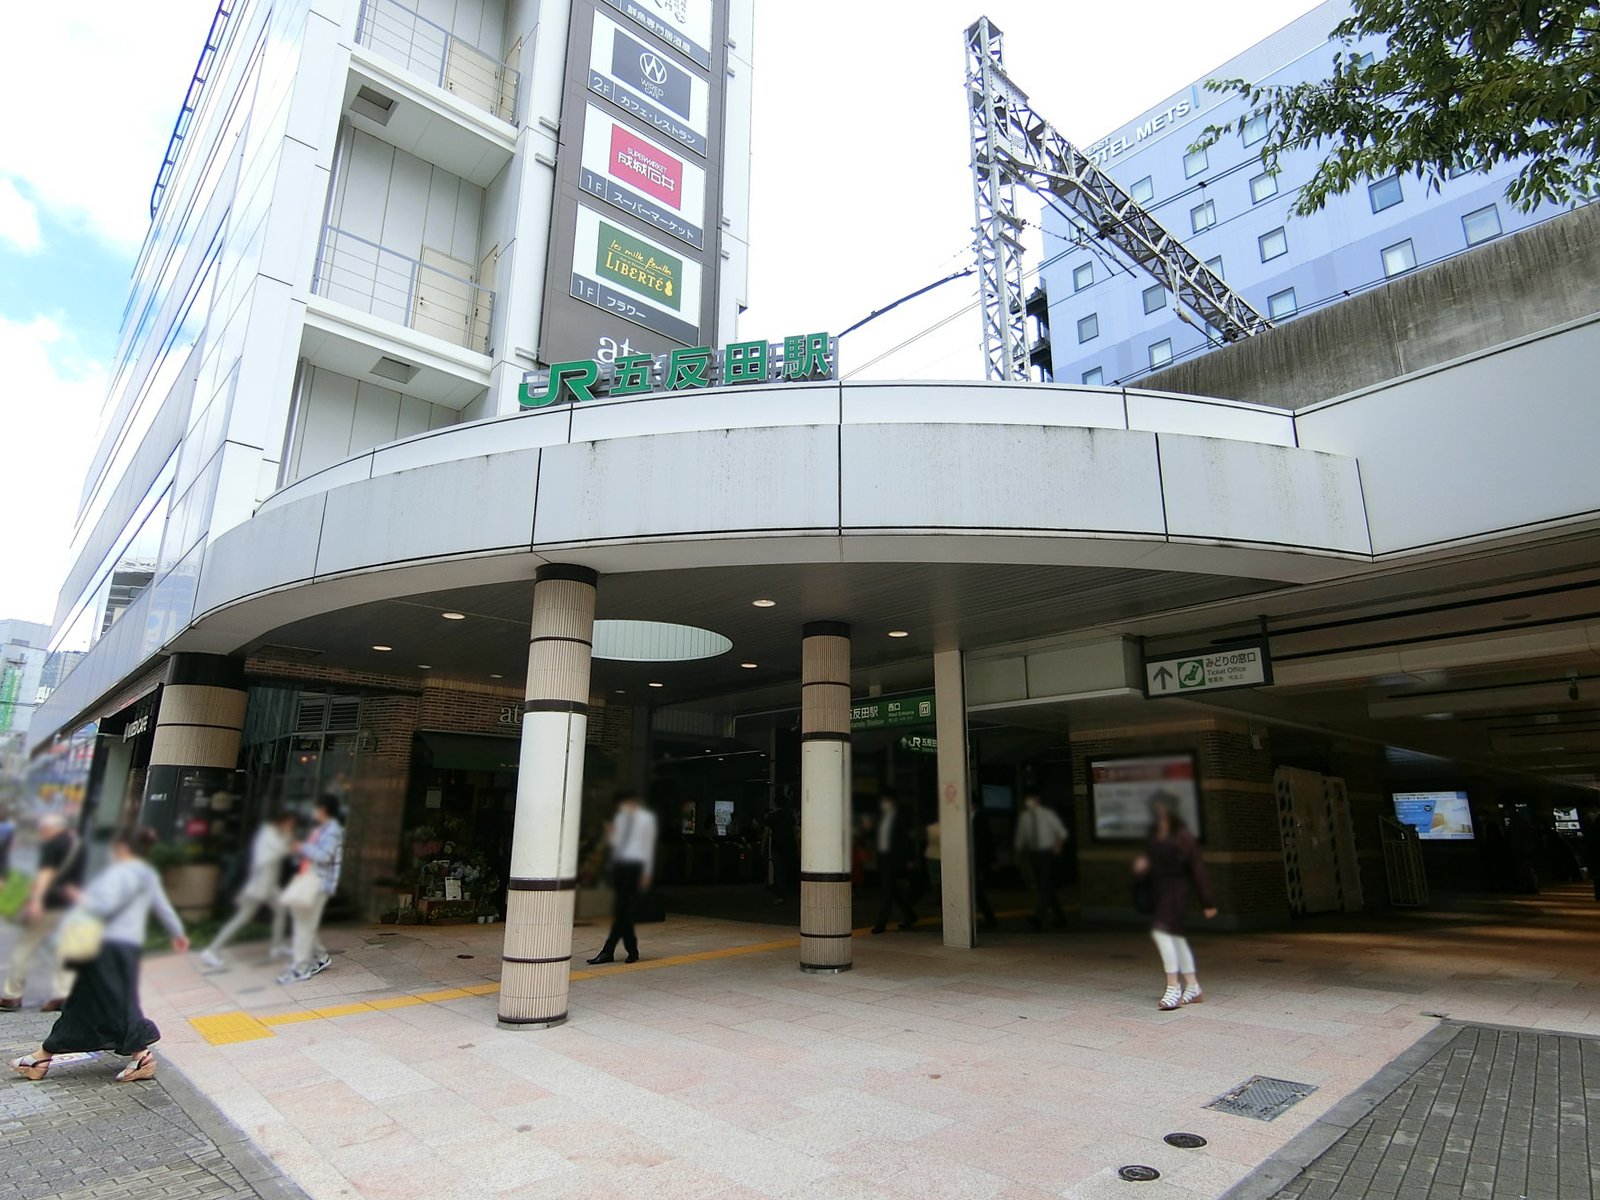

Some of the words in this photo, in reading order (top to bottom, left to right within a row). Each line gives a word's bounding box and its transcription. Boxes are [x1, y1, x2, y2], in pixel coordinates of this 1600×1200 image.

[640, 77, 664, 96] WIRED
[593, 77, 610, 94] 2F
[621, 95, 696, 144] カフェ・レストラン
[1088, 136, 1135, 166] OTEL
[1136, 99, 1191, 142] METS
[617, 151, 675, 191] 成城石井
[627, 147, 668, 173] SUPERMARKET
[587, 175, 602, 192] 1F
[614, 191, 694, 239] スーパーマーケット
[578, 280, 594, 298] 1F
[606, 296, 647, 318] フラワー
[1205, 652, 1256, 667] みどりの窓口
[1207, 668, 1226, 676] Ticket
[1227, 666, 1247, 674] Office
[888, 702, 900, 712] 西口
[908, 737, 921, 748] JR
